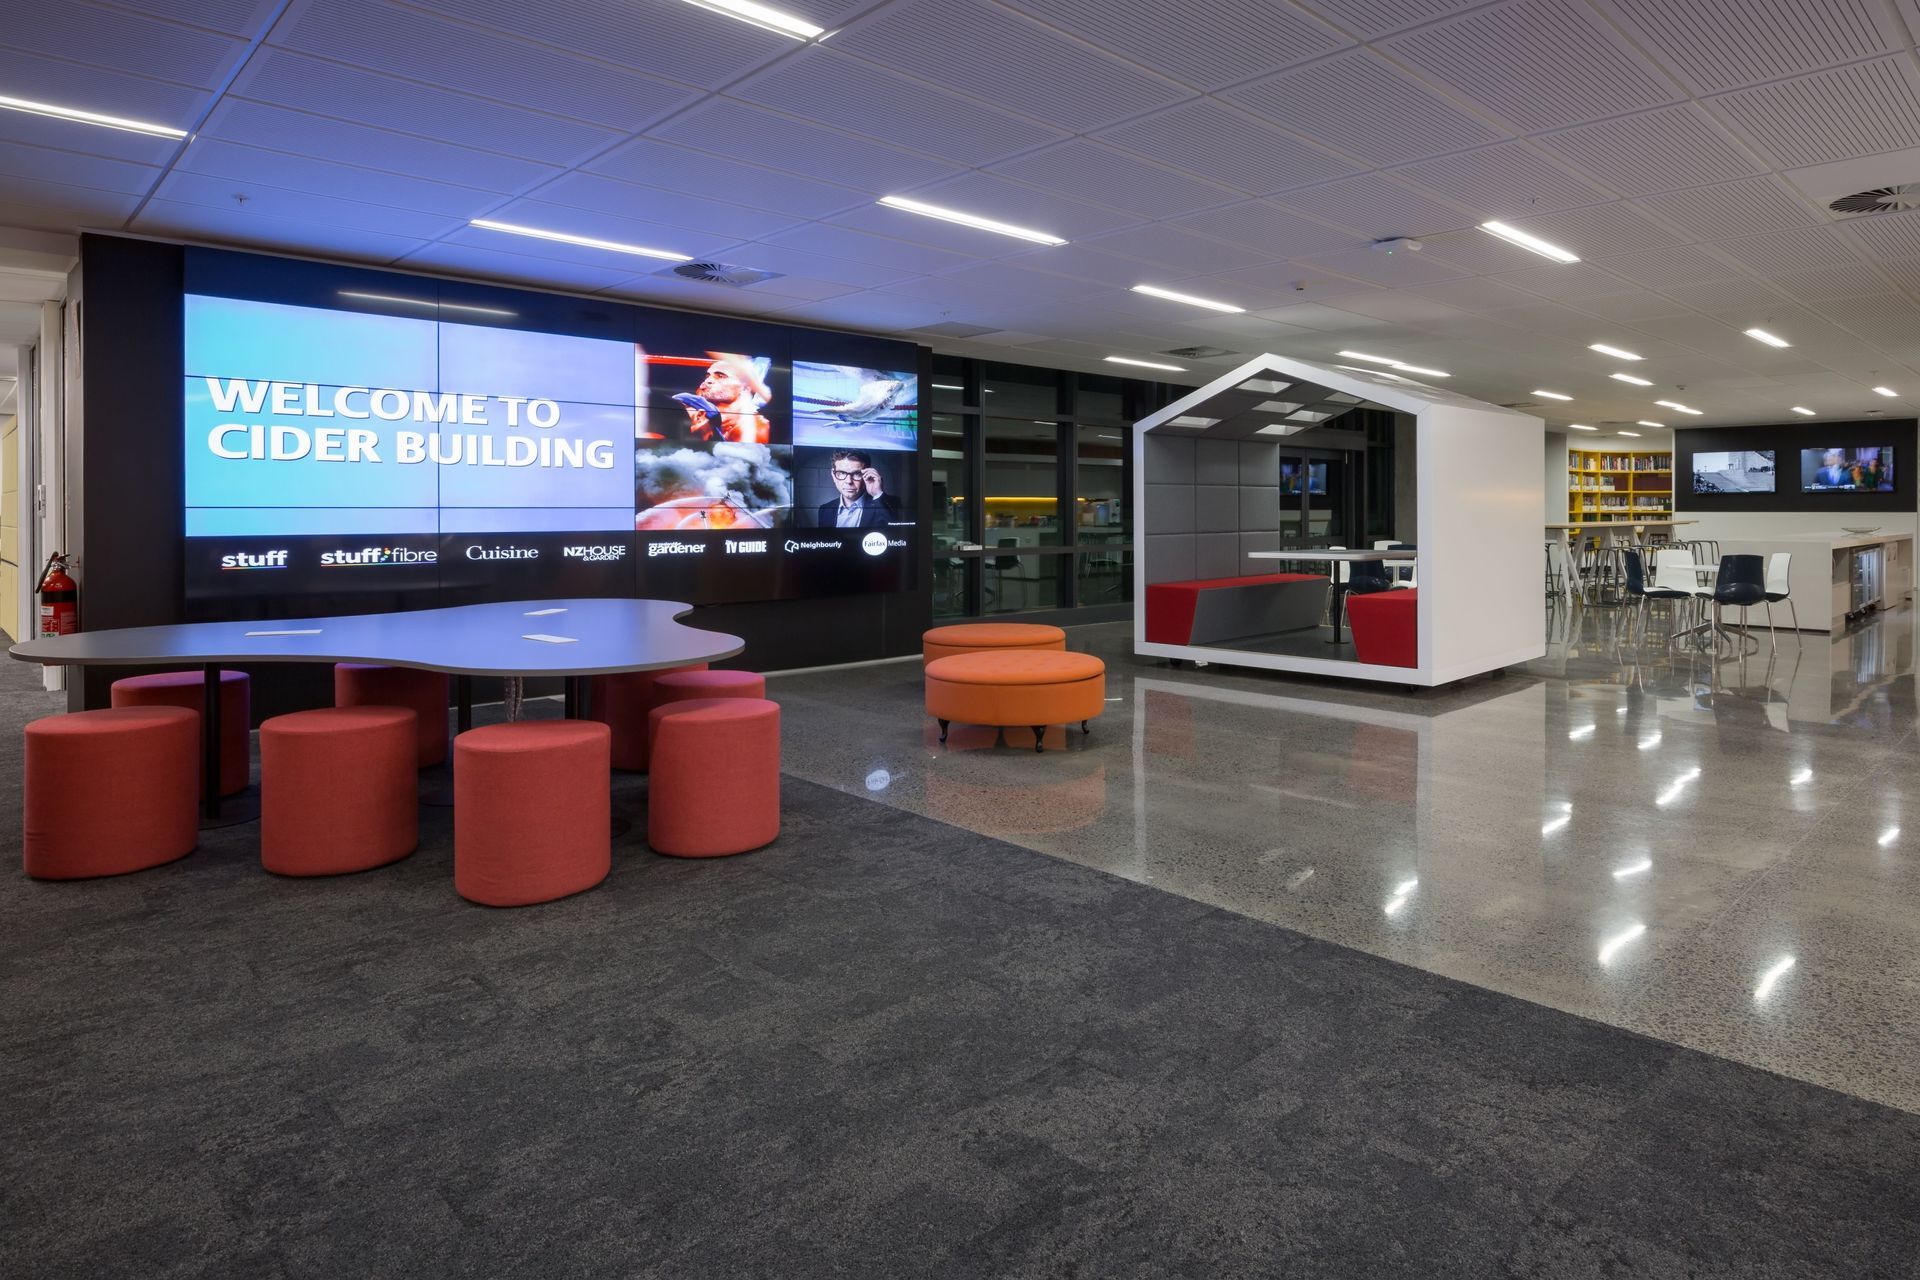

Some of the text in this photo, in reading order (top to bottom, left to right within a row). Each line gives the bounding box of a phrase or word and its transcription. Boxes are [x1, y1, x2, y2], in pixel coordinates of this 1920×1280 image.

[206, 376, 561, 429] WELCOME TO
[207, 423, 615, 469] CIDER BUILDING
[648, 543, 706, 557] gardener
[738, 541, 767, 553] GUIDE
[800, 541, 842, 549] Neighbourly
[222, 550, 288, 567] stuff
[321, 547, 437, 565] stuff fibre
[466, 546, 539, 560] Cuisine
